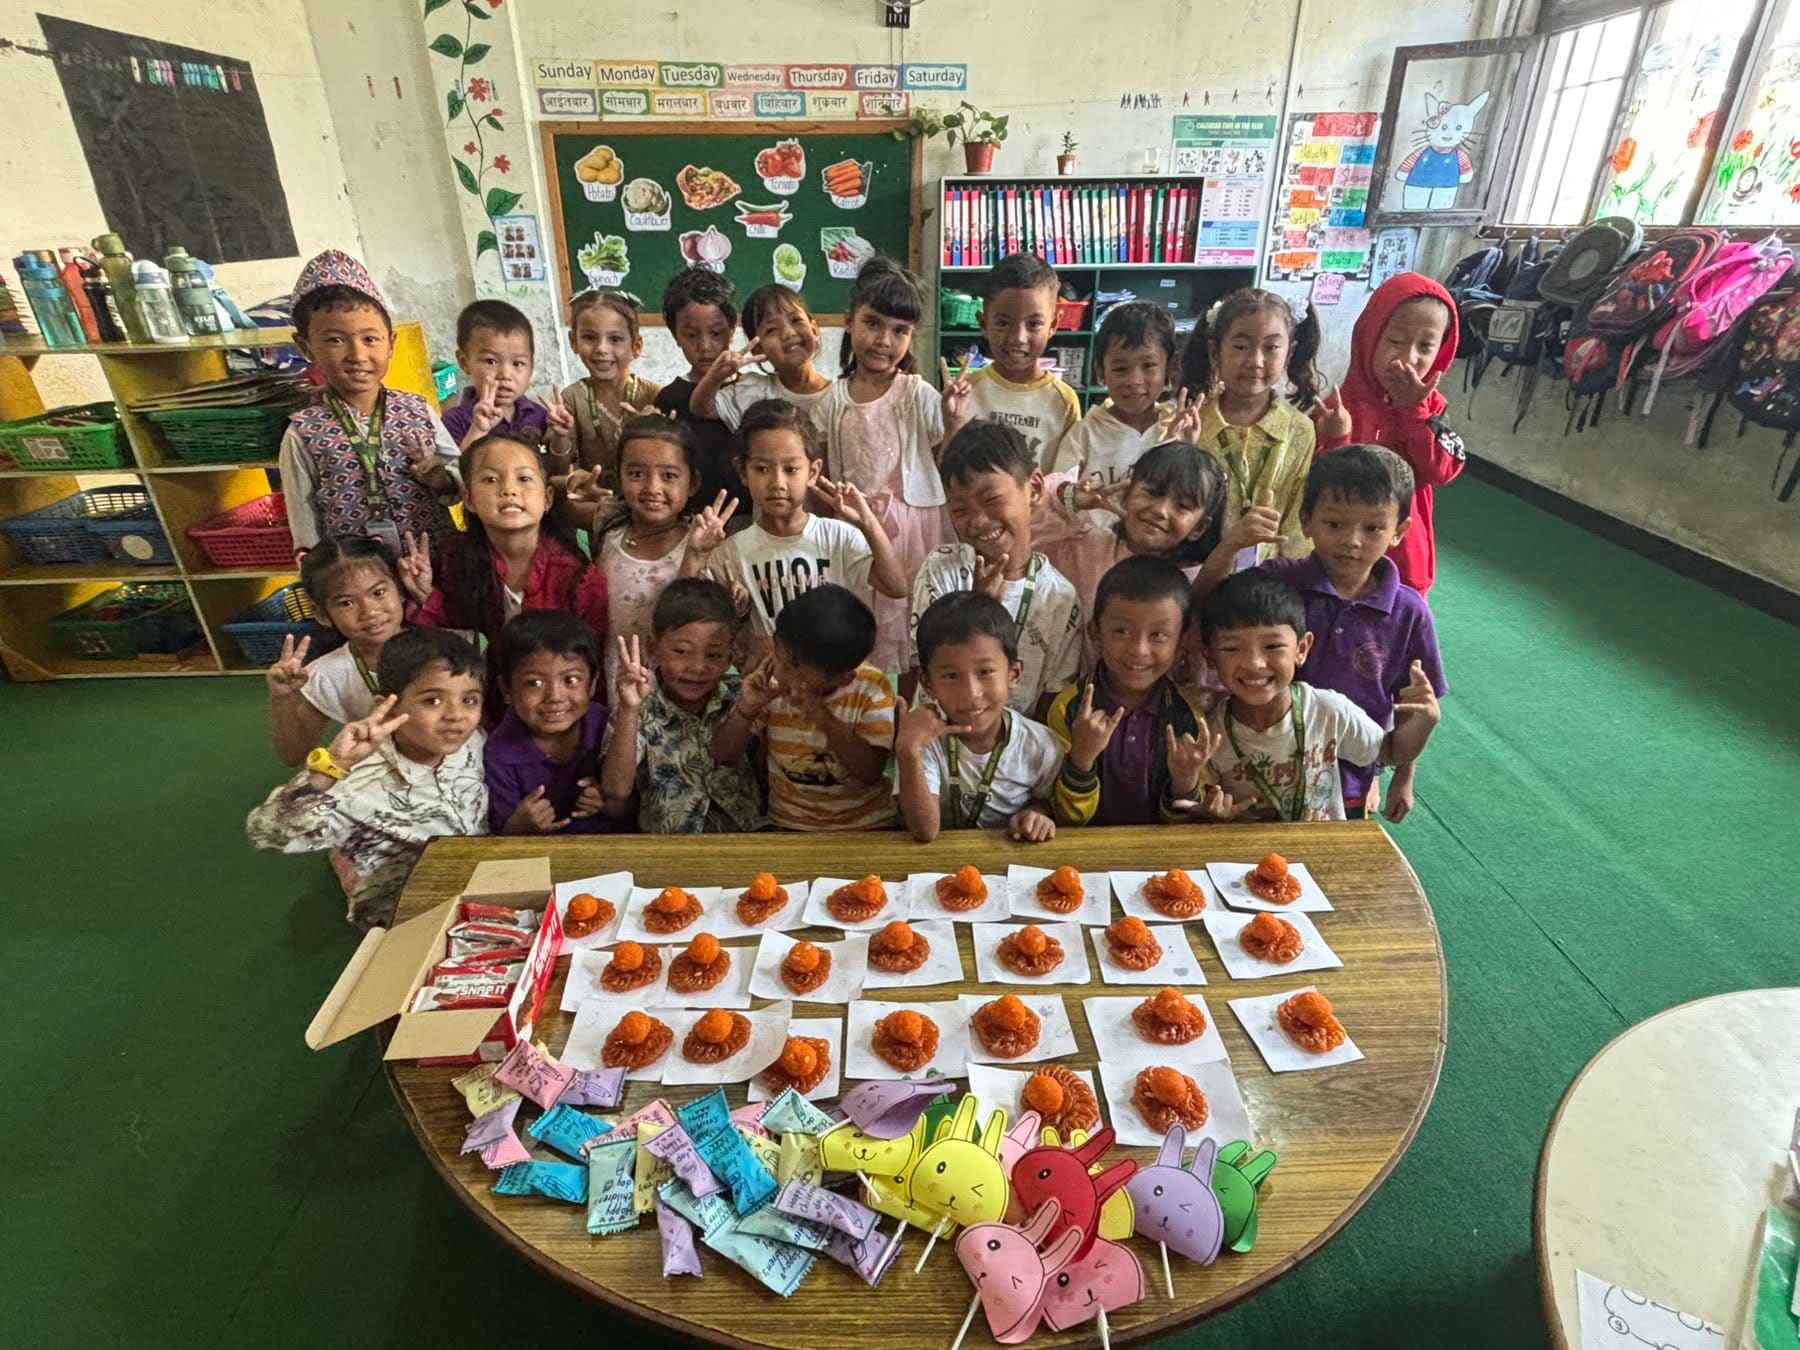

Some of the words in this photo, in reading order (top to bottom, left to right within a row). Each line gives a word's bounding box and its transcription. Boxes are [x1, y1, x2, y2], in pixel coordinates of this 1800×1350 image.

[538, 63, 592, 80] Sunday
[600, 66, 655, 81] Monday
[662, 65, 718, 82] Tuesday
[727, 71, 781, 82] Wednesday
[791, 69, 844, 83] Thursday
[857, 71, 897, 86] Friday
[909, 69, 962, 84] Saturday
[588, 184, 614, 199] Potato
[1318, 275, 1345, 290] Story
[462, 985, 492, 995] SNAP
[493, 985, 508, 995] IT
[617, 1175, 632, 1189] day
[605, 1202, 633, 1216] Happy
